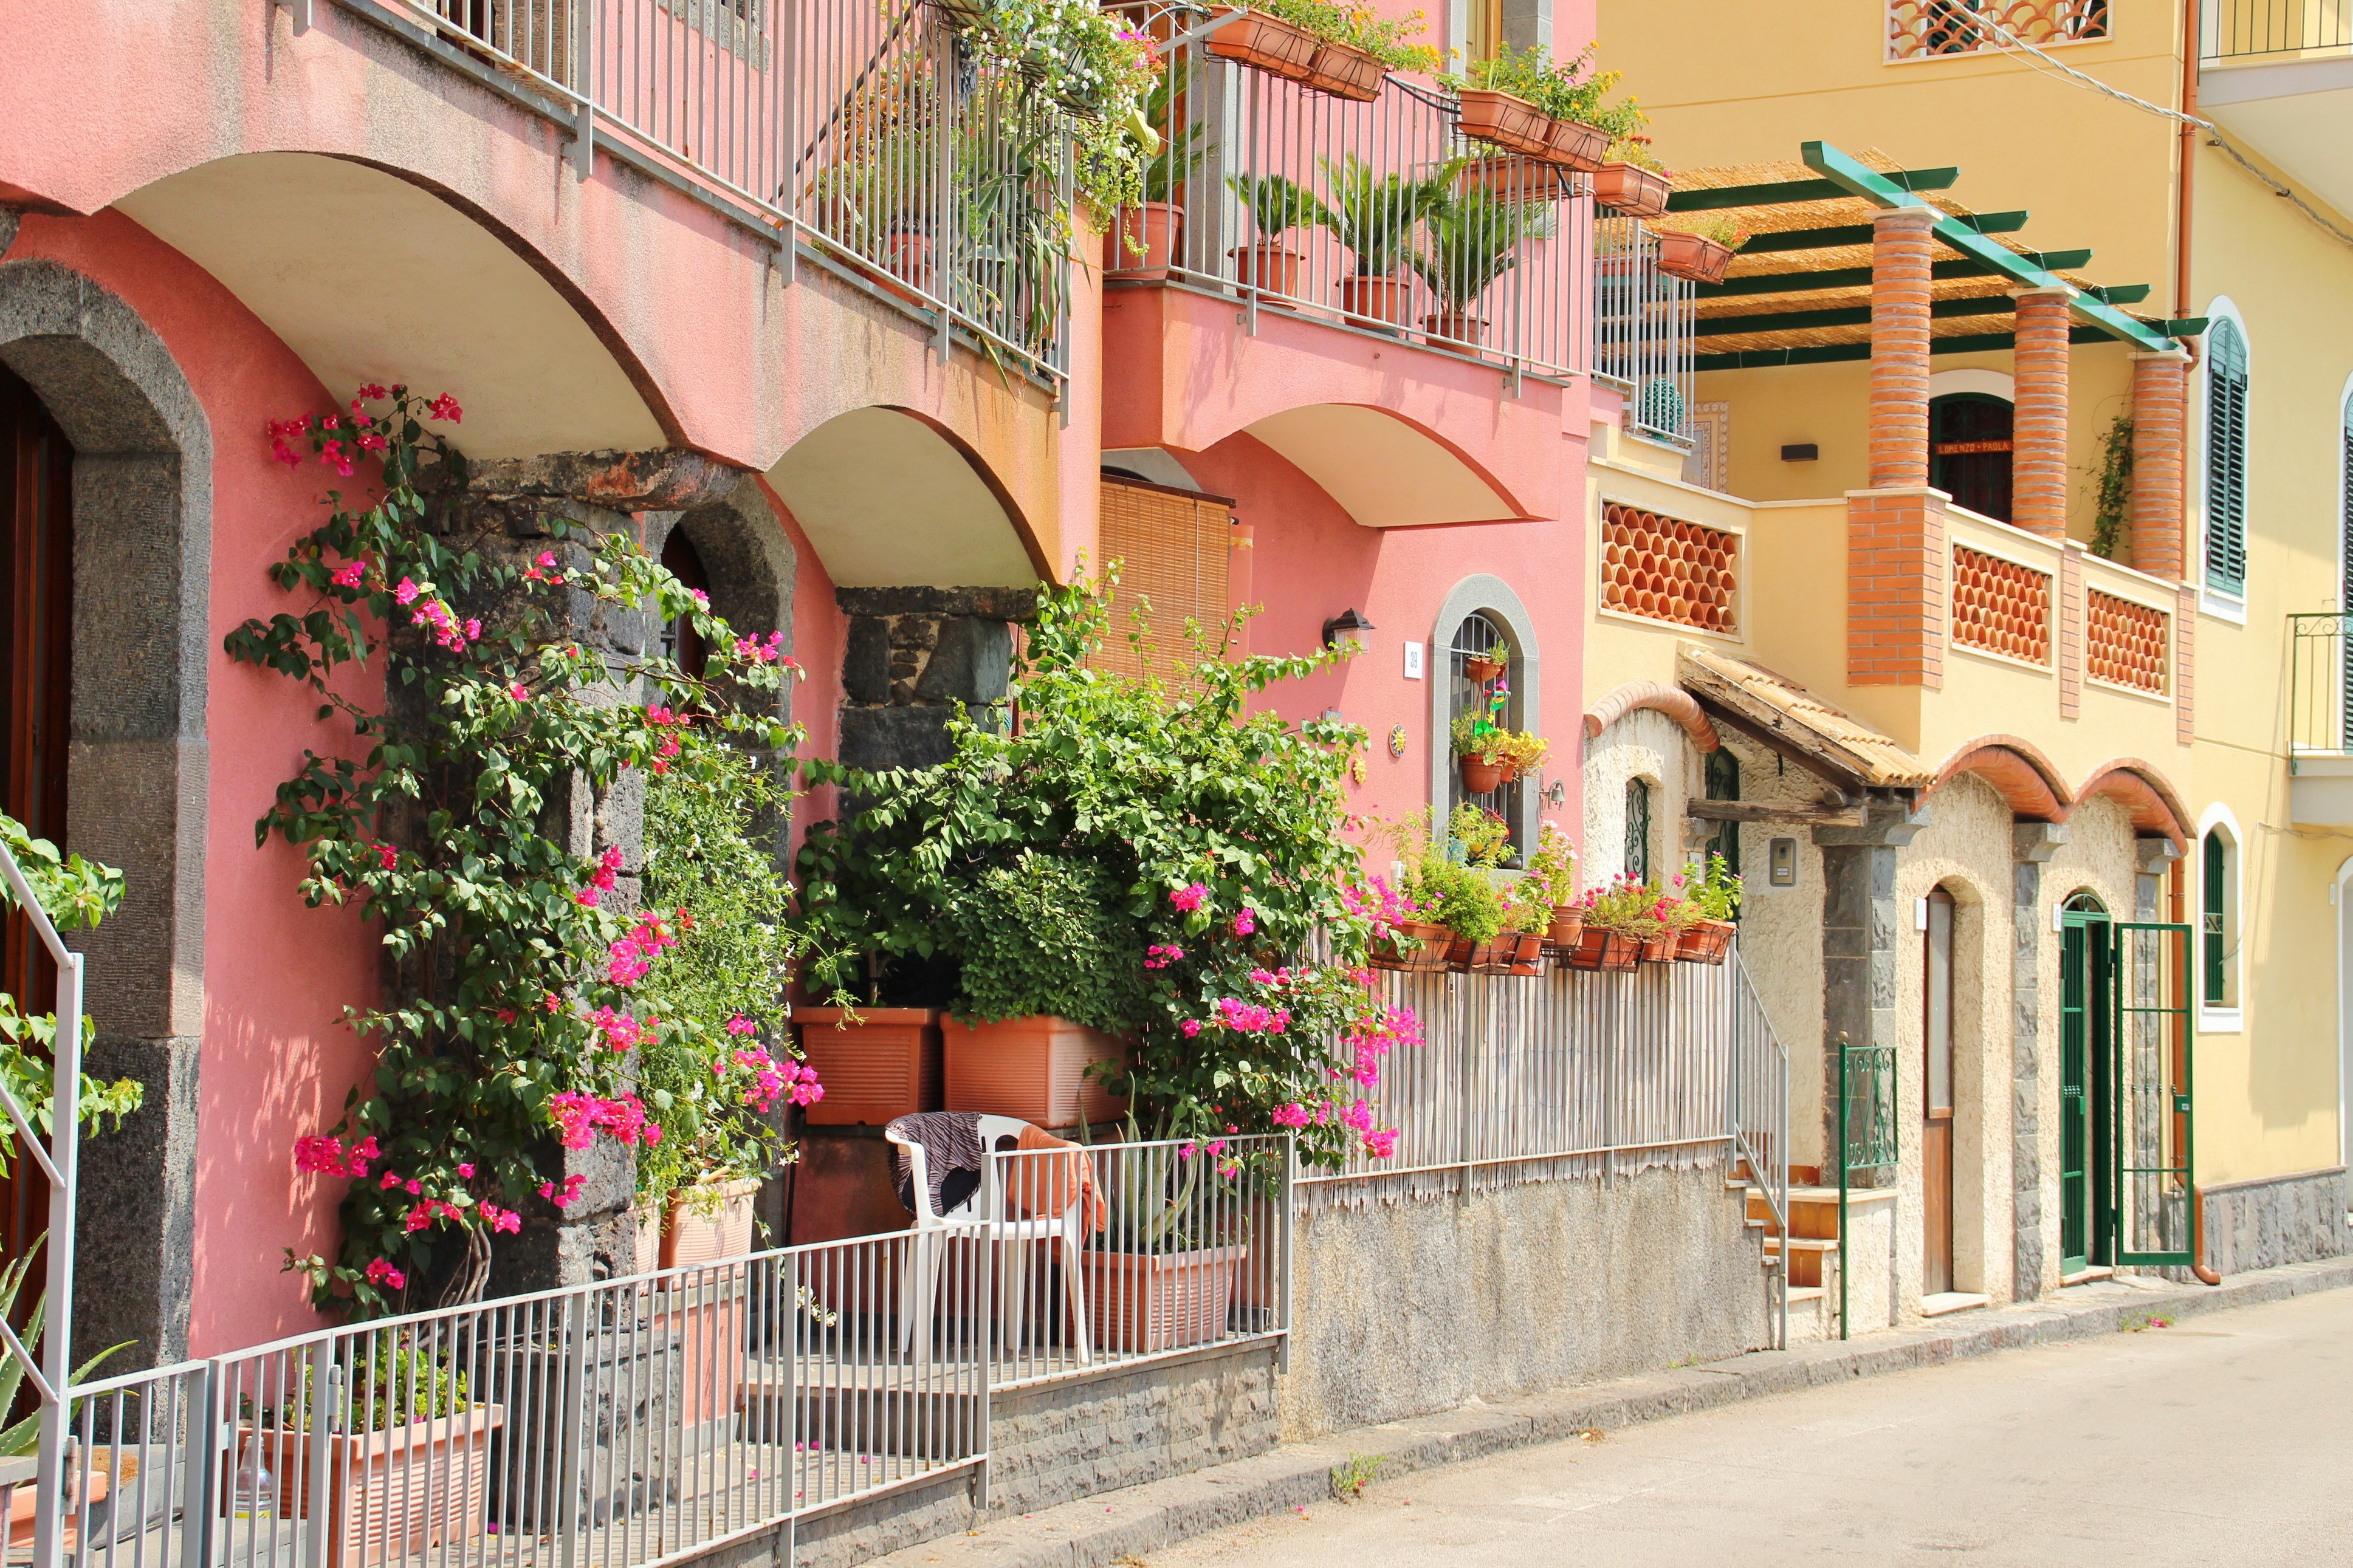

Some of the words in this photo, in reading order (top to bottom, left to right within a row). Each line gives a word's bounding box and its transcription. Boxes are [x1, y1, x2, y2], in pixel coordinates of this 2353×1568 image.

[1939, 443, 1975, 453] LORENZO
[1983, 442, 2008, 451] PAOLA
[1410, 651, 1418, 668] 39
